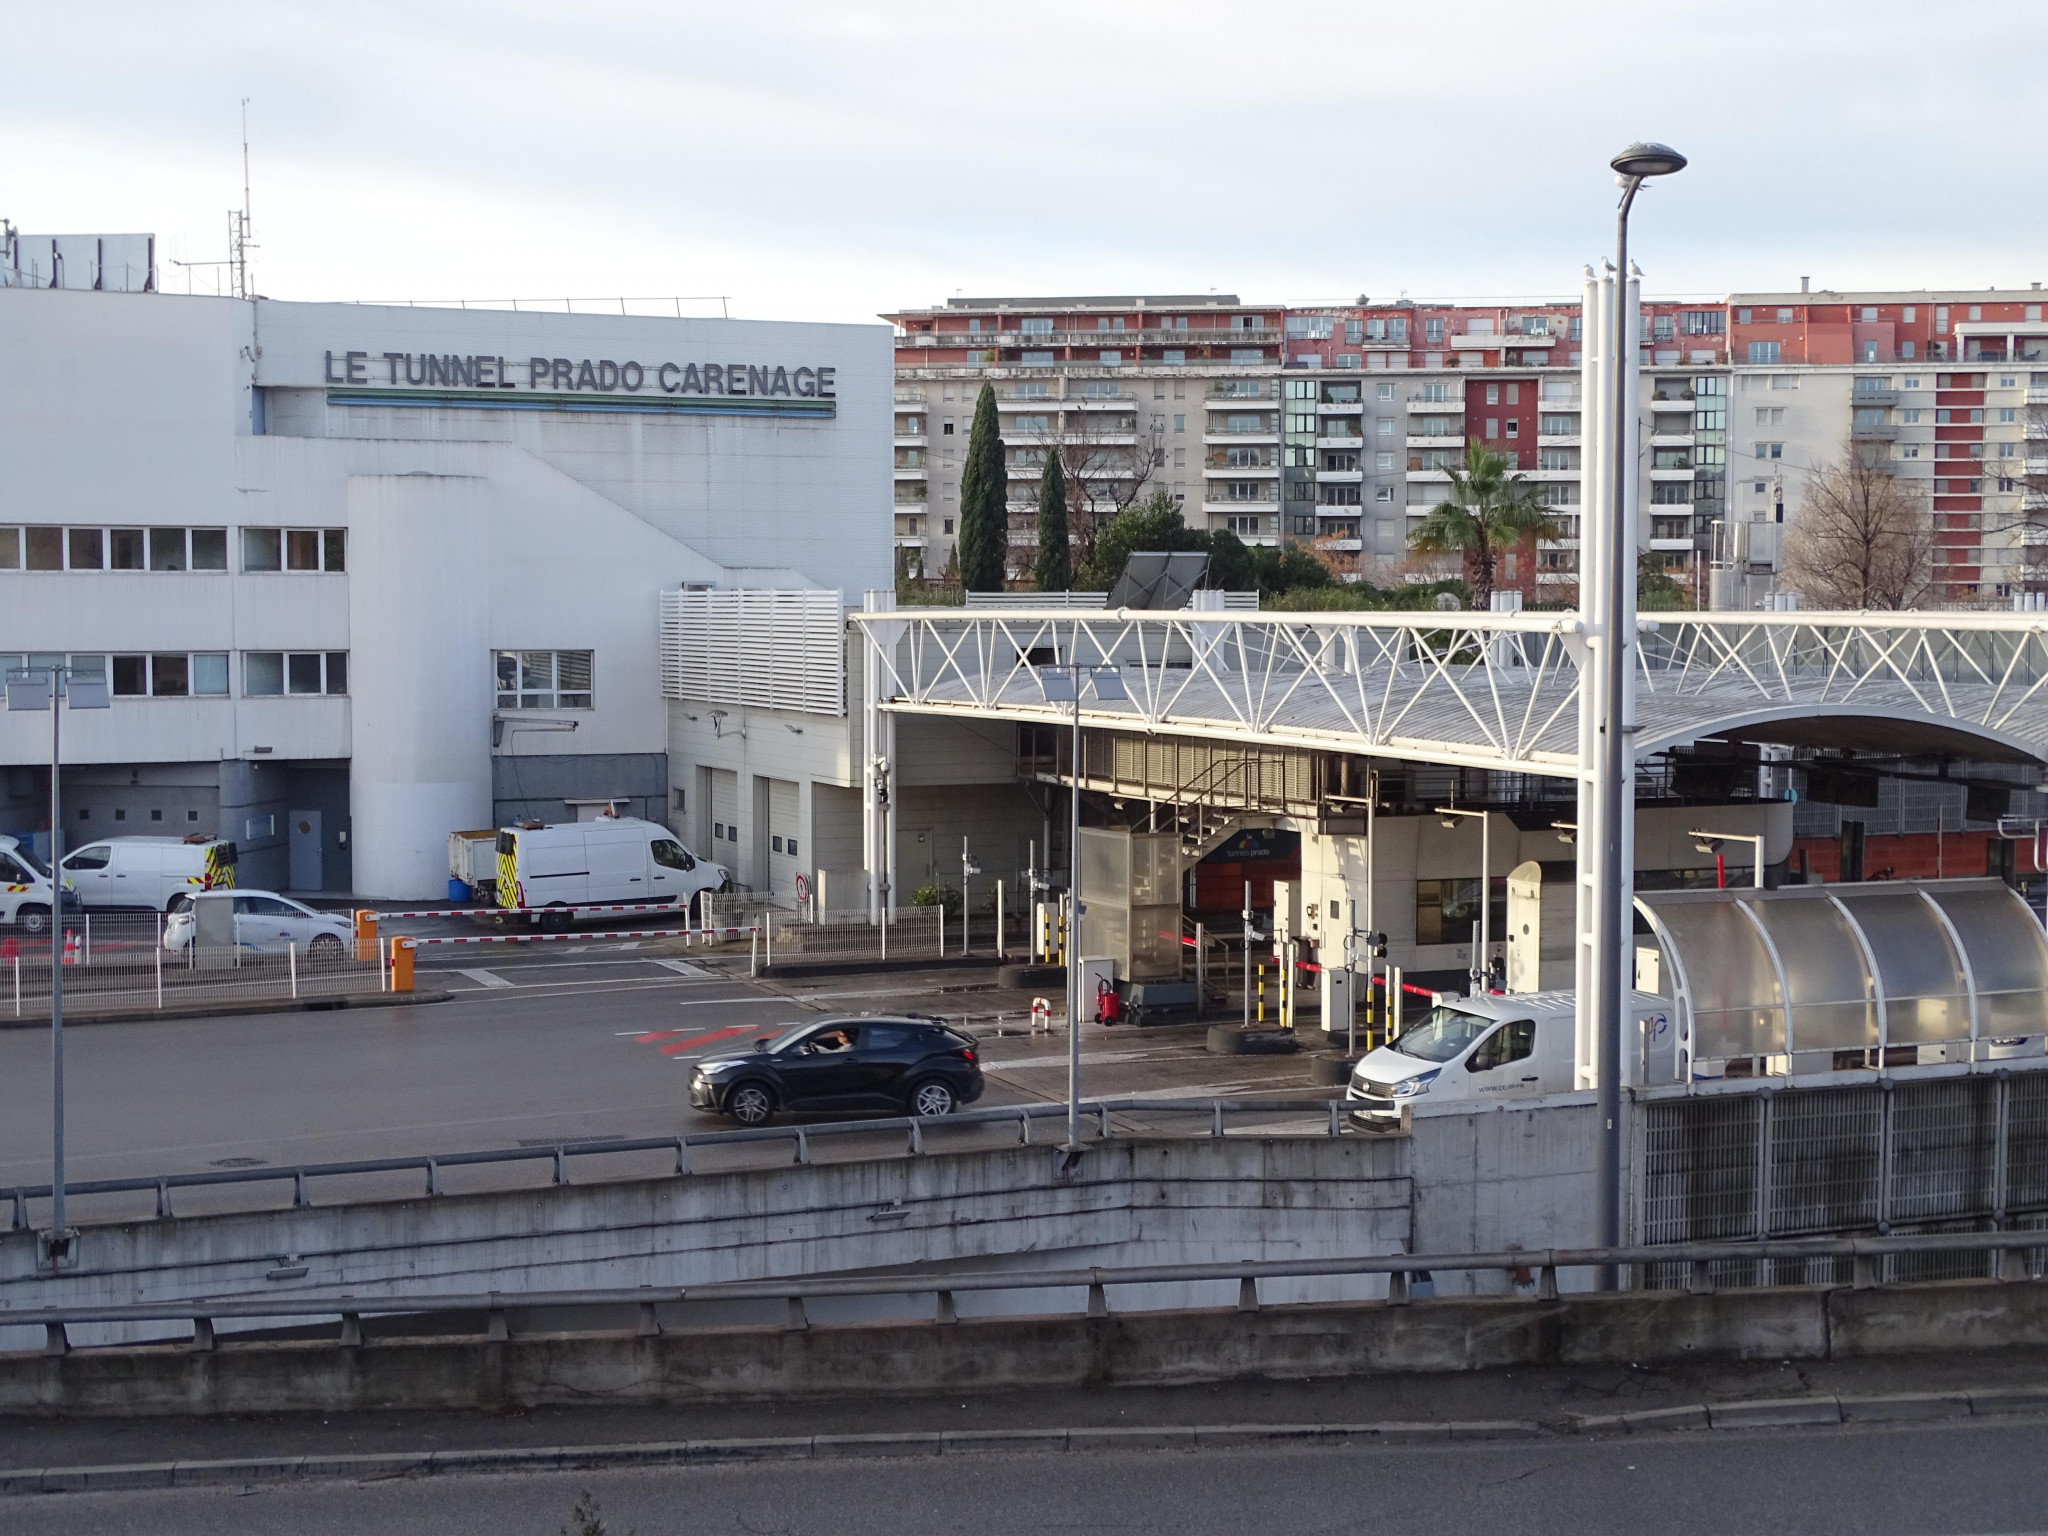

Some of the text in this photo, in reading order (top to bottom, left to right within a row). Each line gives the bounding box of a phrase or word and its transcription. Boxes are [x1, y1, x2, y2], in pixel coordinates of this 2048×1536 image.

[325, 350, 836, 398] LE TUNNEL PRADO CARENAGE
